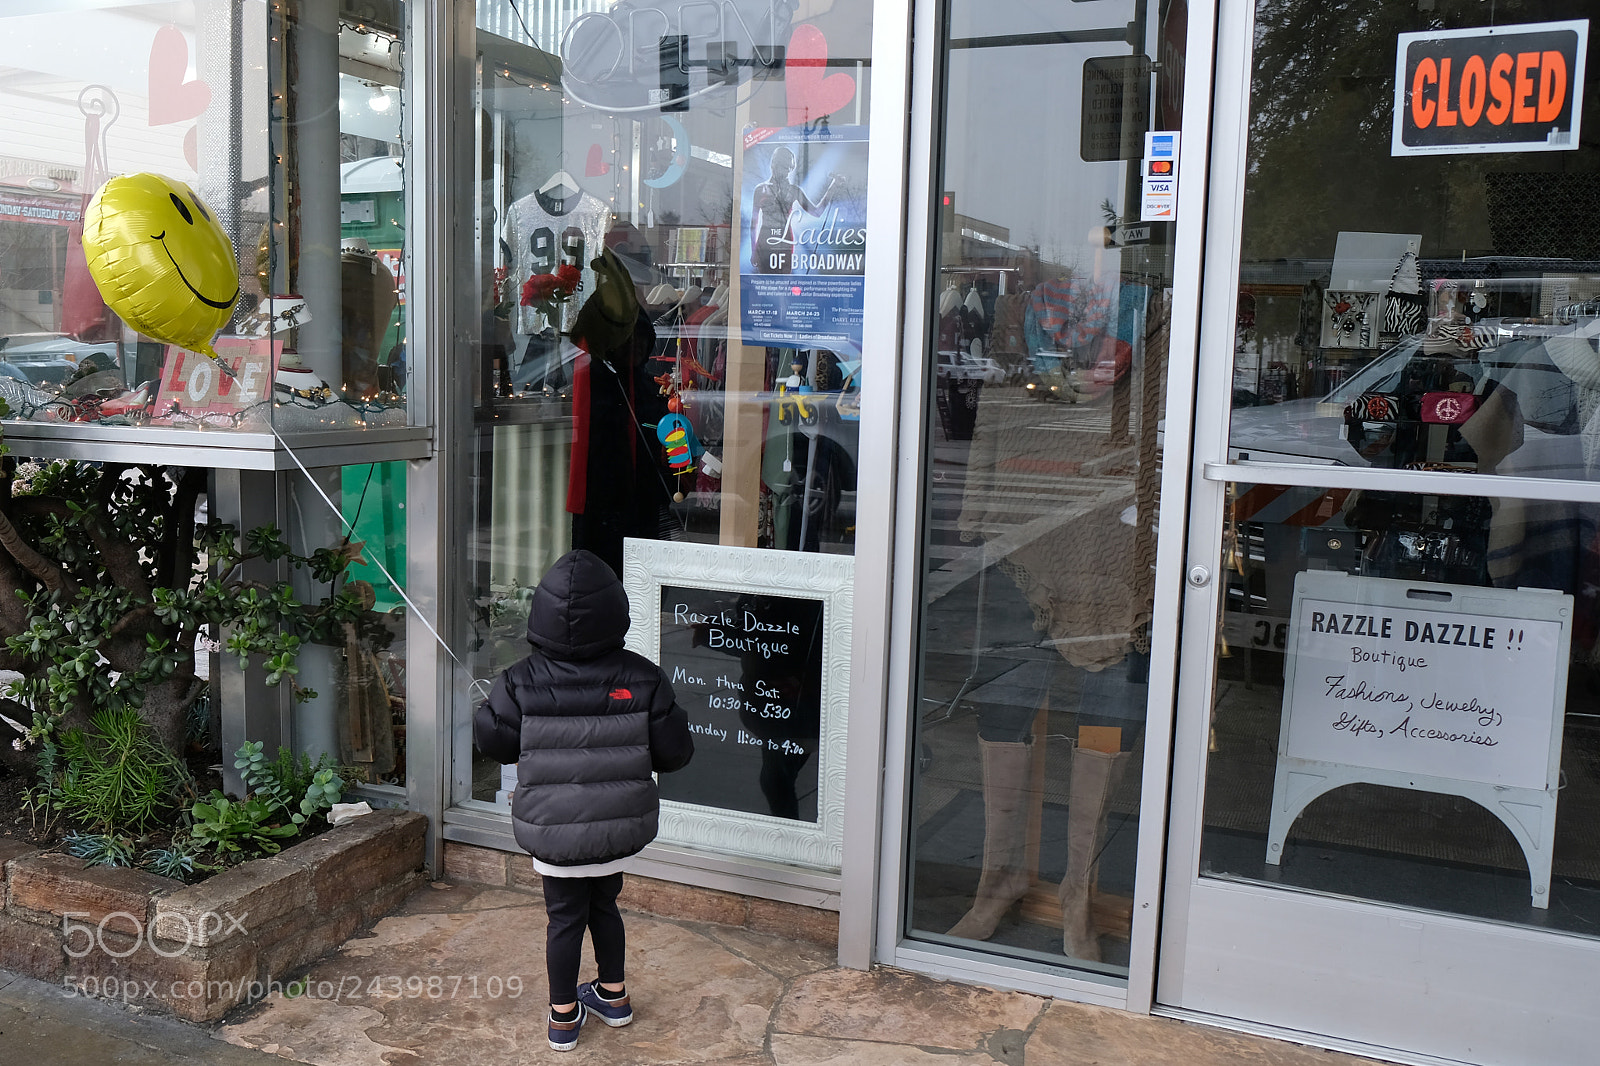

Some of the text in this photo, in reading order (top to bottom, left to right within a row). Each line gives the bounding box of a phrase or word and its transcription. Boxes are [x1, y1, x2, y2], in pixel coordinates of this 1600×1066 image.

[560, 0, 775, 84] OPEN
[1411, 51, 1567, 129] CLOSED
[1150, 184, 1170, 192] VISA
[766, 207, 868, 246] THE Ladies
[530, 226, 585, 275] 99
[769, 253, 863, 271] OF BROADWAY
[168, 352, 264, 403] LOVE
[674, 603, 800, 635] Razzle Dazzle
[1311, 611, 1393, 639] RAZZLE
[1404, 620, 1496, 650] DAZZLE
[709, 629, 789, 659] Boutique
[1350, 646, 1428, 672] Boutique
[672, 666, 707, 686] Mon.
[716, 675, 745, 692] thru
[708, 694, 791, 719] 10:30 to 5:30
[1325, 675, 1503, 726] Fashions, Jewelry,
[687, 721, 804, 755] unday 11:00 to 4:00
